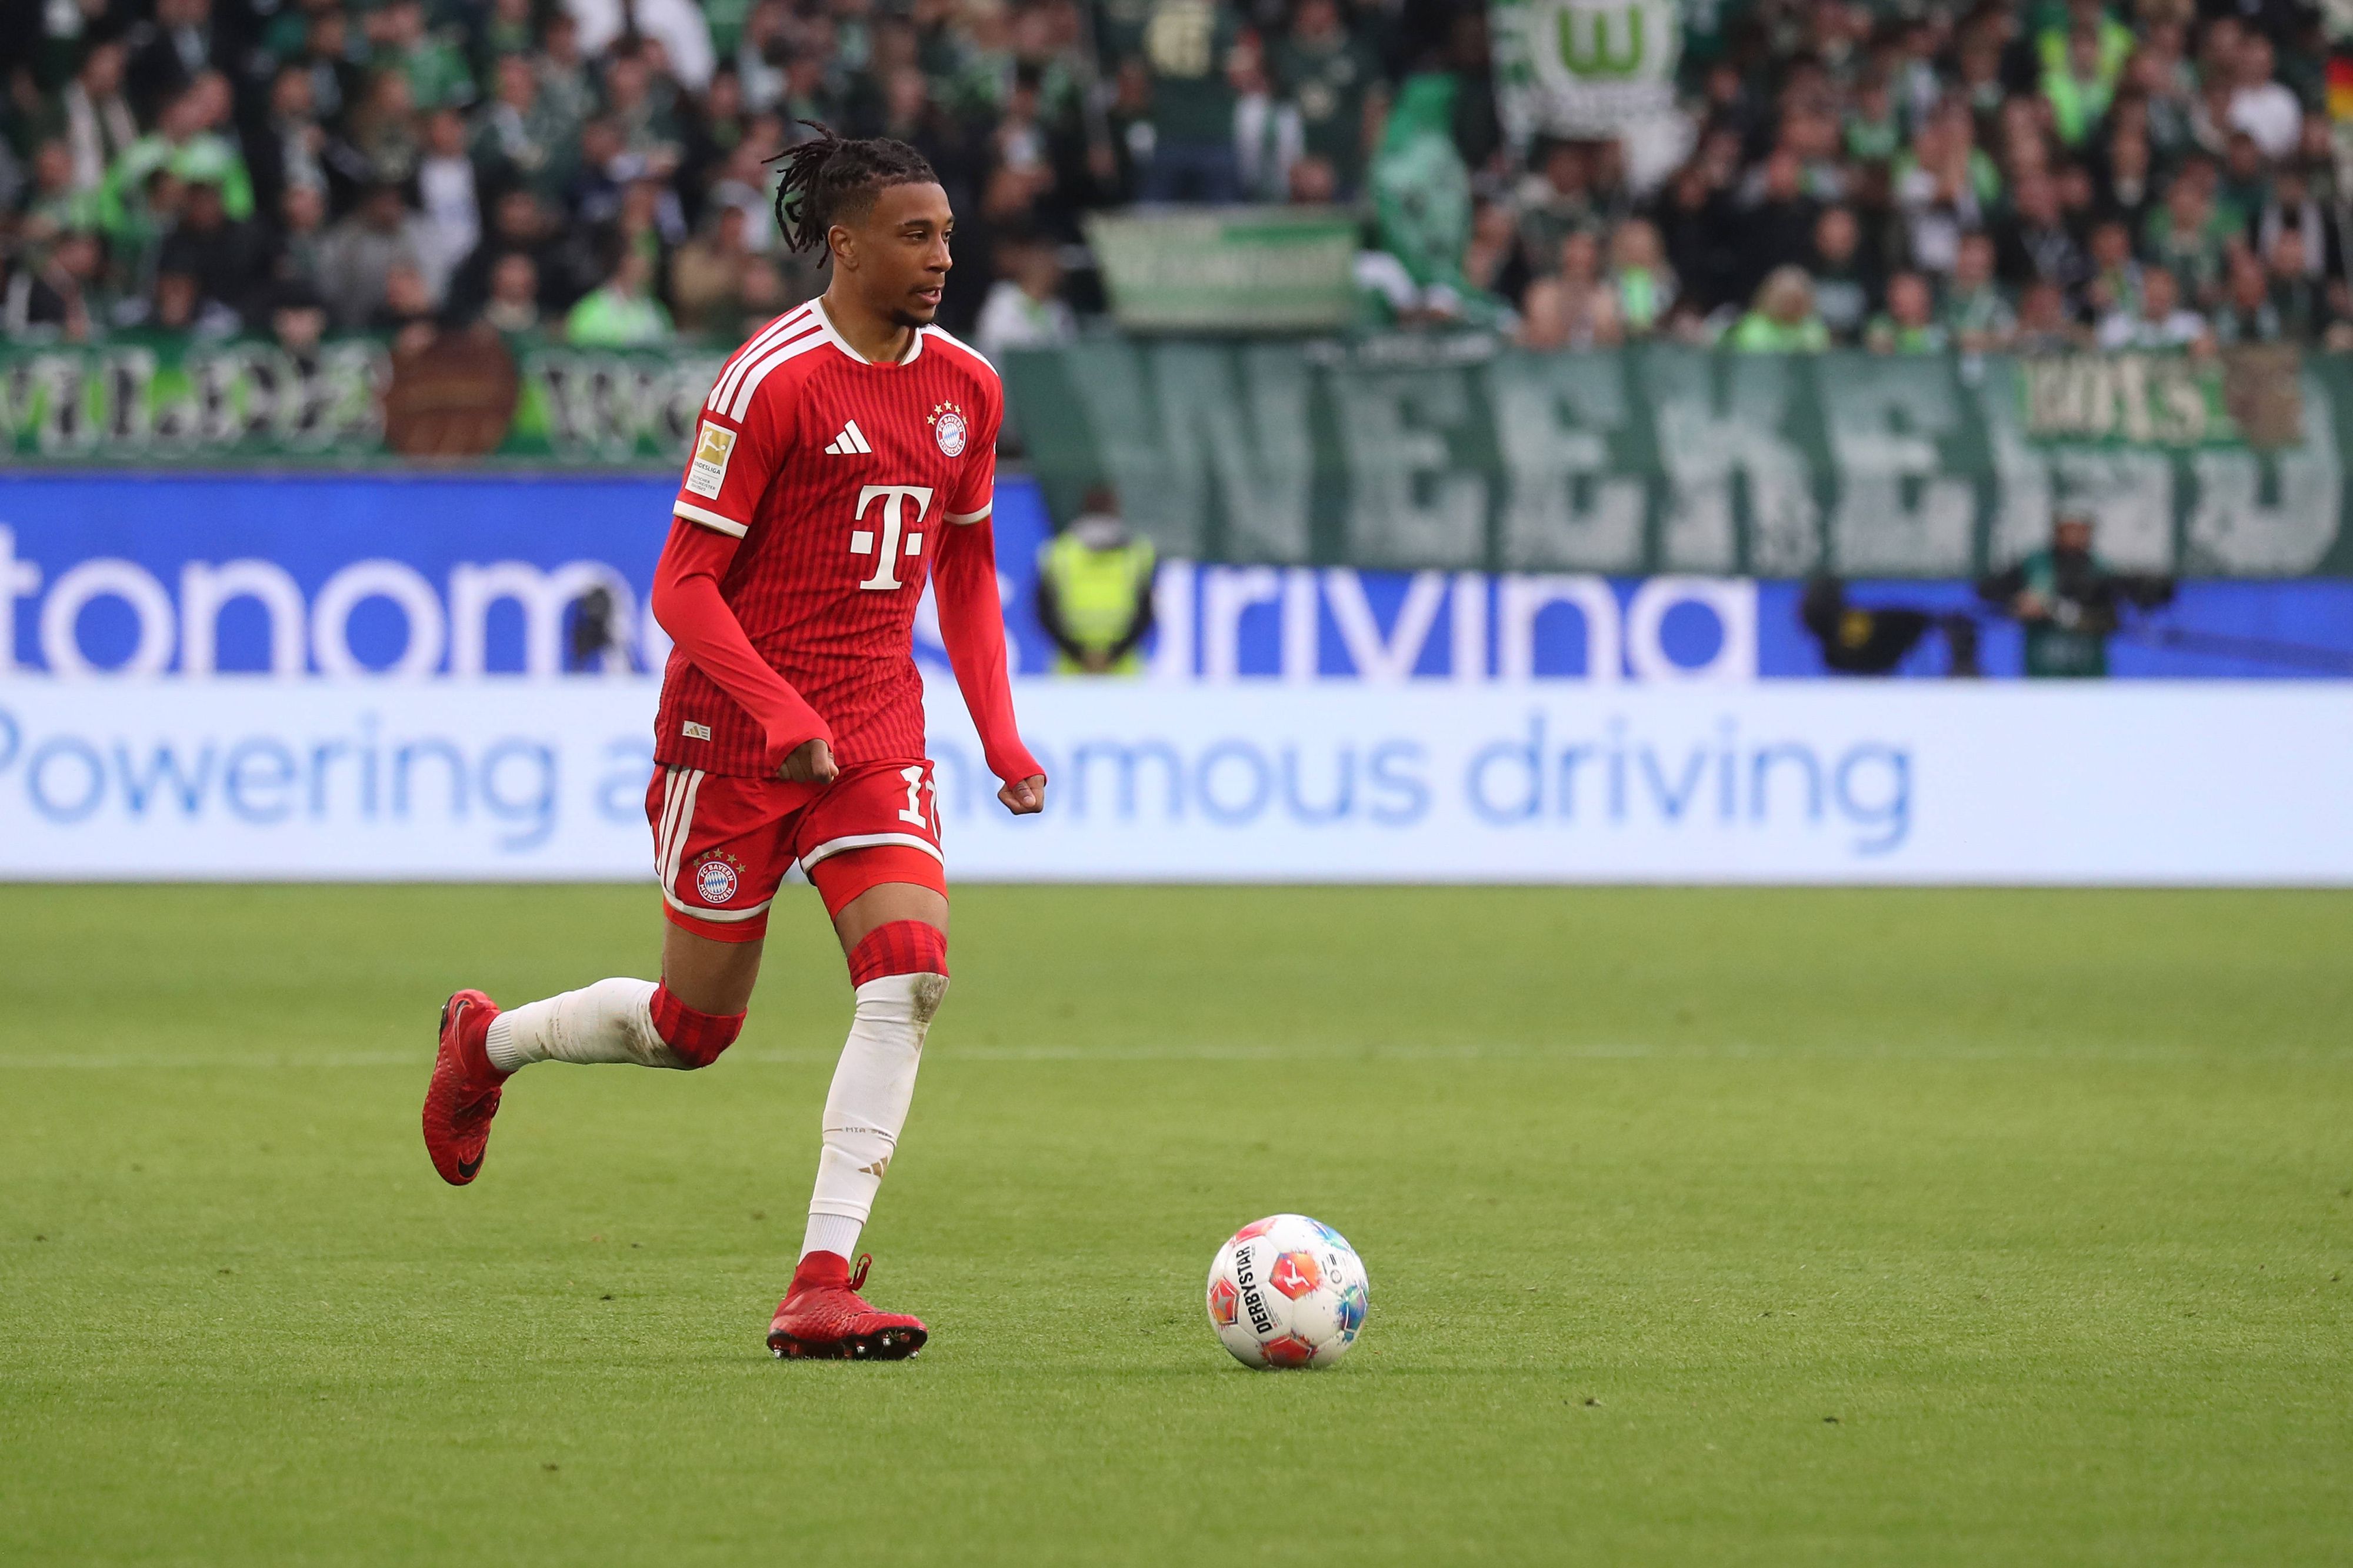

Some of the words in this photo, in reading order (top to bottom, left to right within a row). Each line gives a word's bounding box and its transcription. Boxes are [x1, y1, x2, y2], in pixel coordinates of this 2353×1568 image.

[1556, 3, 1644, 79] W
[944, 416, 963, 433] BAYERN
[0, 708, 556, 850] owering
[1472, 712, 1912, 856] driving
[708, 865, 734, 881] BAYERN
[1235, 1245, 1274, 1335] DERBYSTAR
